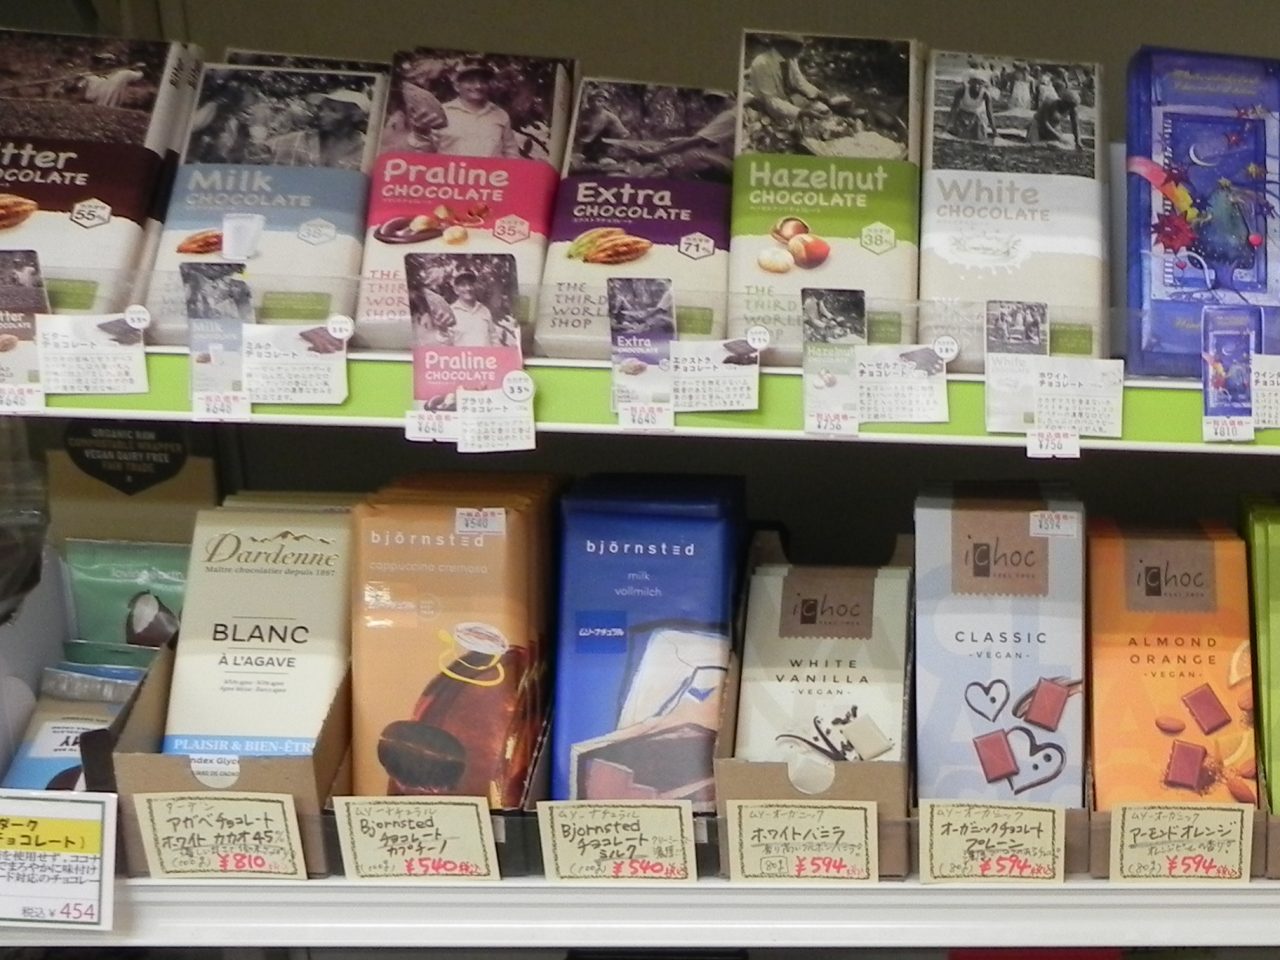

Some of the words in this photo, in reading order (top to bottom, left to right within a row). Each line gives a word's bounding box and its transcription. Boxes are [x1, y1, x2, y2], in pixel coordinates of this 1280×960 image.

[187, 170, 273, 191] Milk
[383, 159, 509, 187] Praline
[749, 161, 888, 191] Hazelnut
[186, 193, 312, 207] CHOCOLATE
[381, 185, 504, 202] CHOCOLATE
[576, 182, 672, 207] Extra
[749, 190, 867, 208] CHOCOLATE
[937, 178, 1039, 205] White
[573, 205, 692, 221] CHOCOLATE
[936, 205, 1051, 222] CHOCOLATE
[424, 351, 497, 370] Praline
[425, 369, 495, 382] CHOCOLATE
[202, 532, 339, 567] Dardenne
[627, 571, 650, 582] milk
[614, 586, 662, 598] vollmilch
[212, 623, 310, 645] BLANC
[955, 631, 1048, 644] CLASSIC
[1128, 636, 1217, 648] ALMOND
[790, 659, 857, 669] WHITE
[1130, 654, 1217, 665] ORANGE
[776, 674, 869, 684] VANILLA
[219, 853, 265, 871] ¥810
